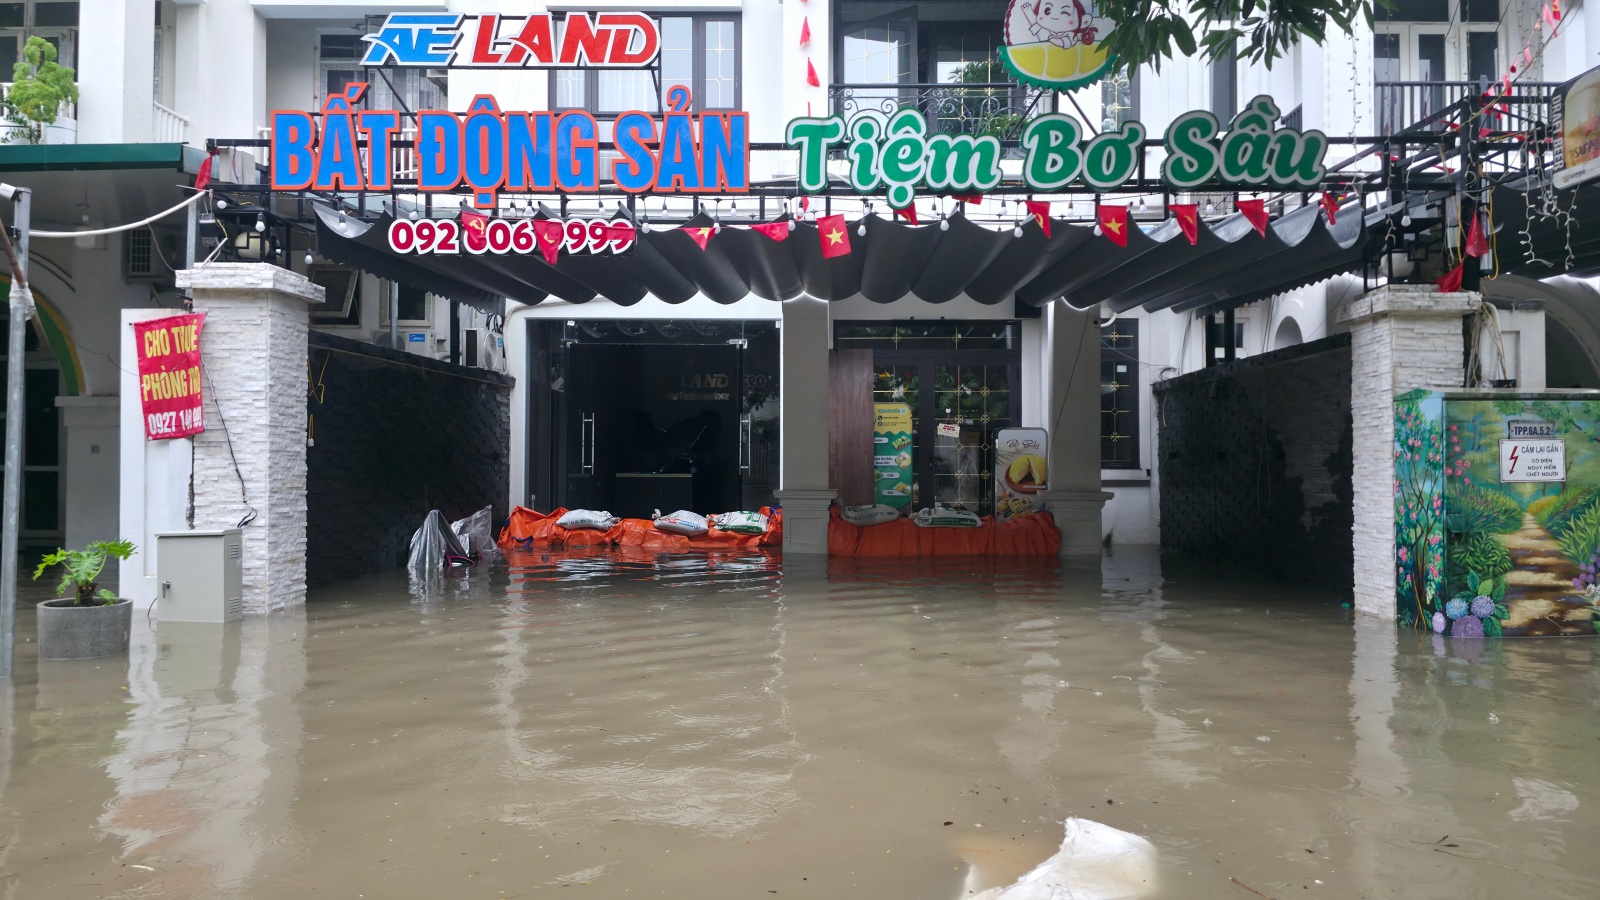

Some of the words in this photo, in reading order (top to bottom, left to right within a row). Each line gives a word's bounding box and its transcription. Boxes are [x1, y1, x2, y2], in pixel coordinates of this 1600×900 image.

[470, 11, 661, 67] LAND
[271, 82, 400, 190] BẤT
[417, 93, 599, 208] ĐỘNG
[612, 84, 750, 192] SẢN
[785, 105, 1003, 210] Tiệm
[1021, 112, 1146, 191] Bơ
[1163, 94, 1328, 191] Sầu
[388, 218, 459, 255] 092
[144, 328, 170, 358] CHO
[142, 365, 187, 401] PHÒNG
[148, 411, 176, 435] 0927
[1514, 426, 1551, 436] TPP.6A.5.2
